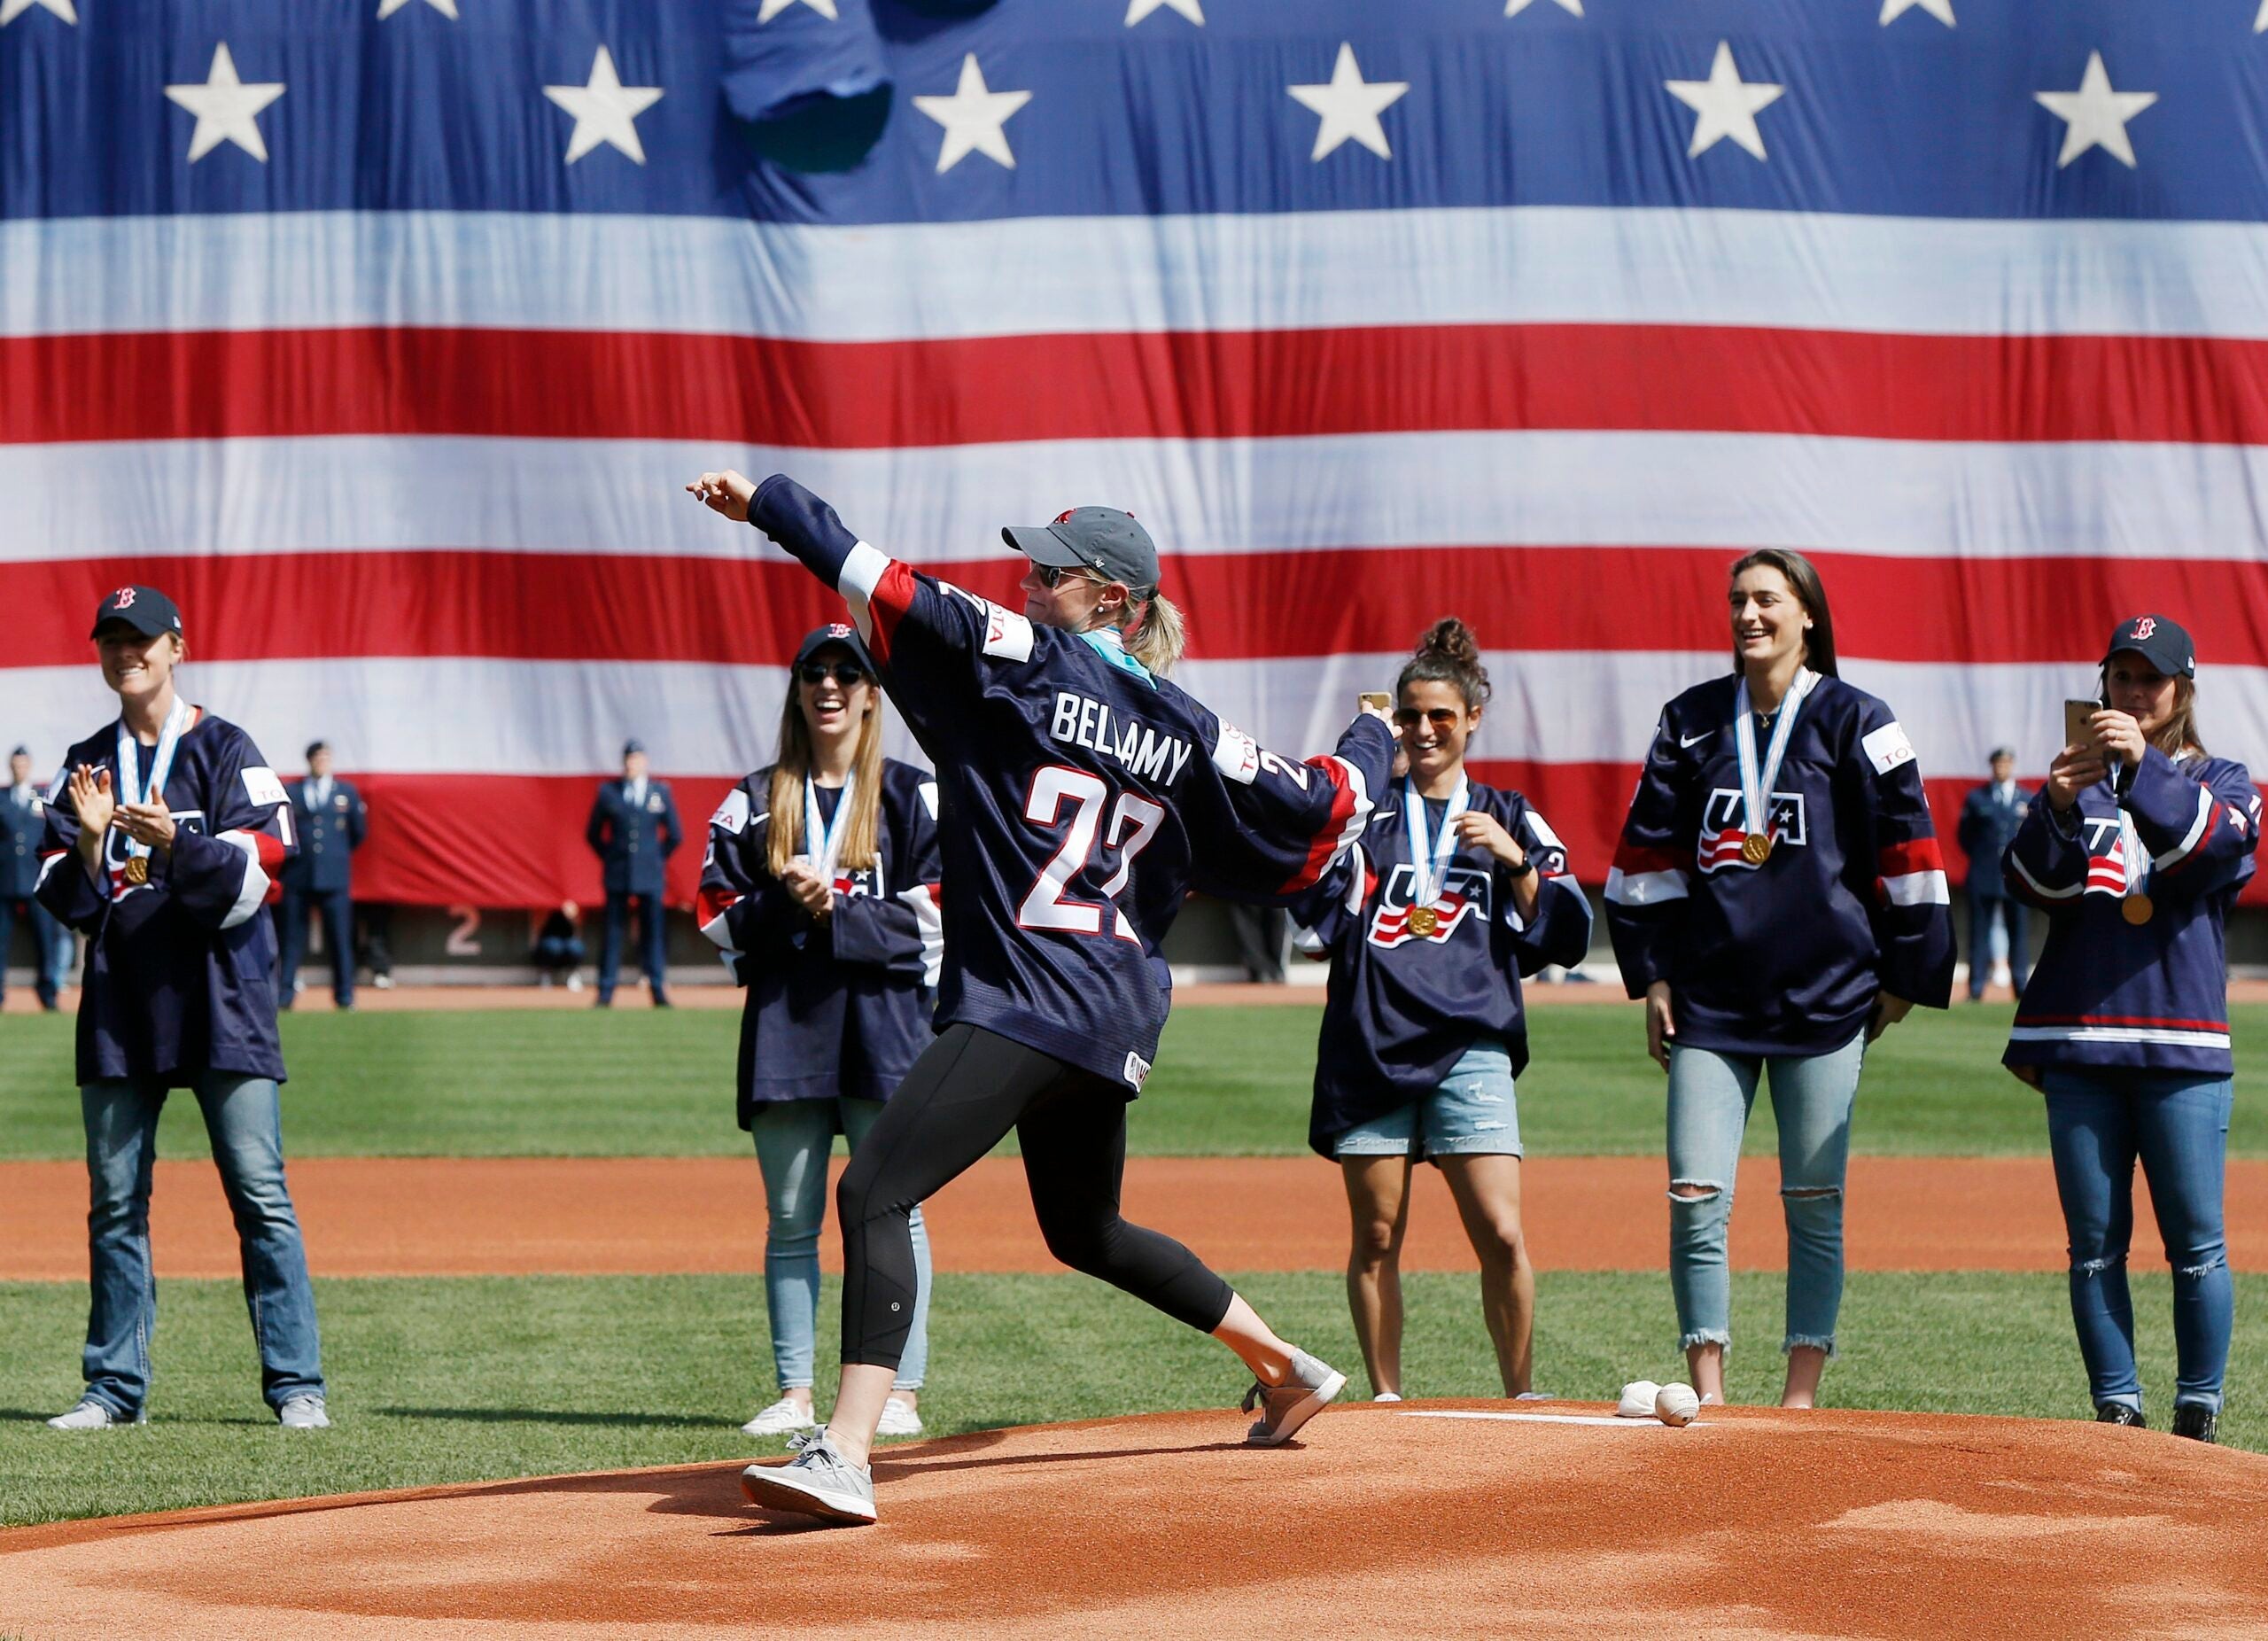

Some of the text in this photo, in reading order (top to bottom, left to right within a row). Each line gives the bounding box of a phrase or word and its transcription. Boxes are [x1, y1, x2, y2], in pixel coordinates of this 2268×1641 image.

[113, 587, 136, 610] B
[2130, 616, 2157, 641] B
[1698, 788, 1806, 874] UA
[446, 903, 482, 956] 2
